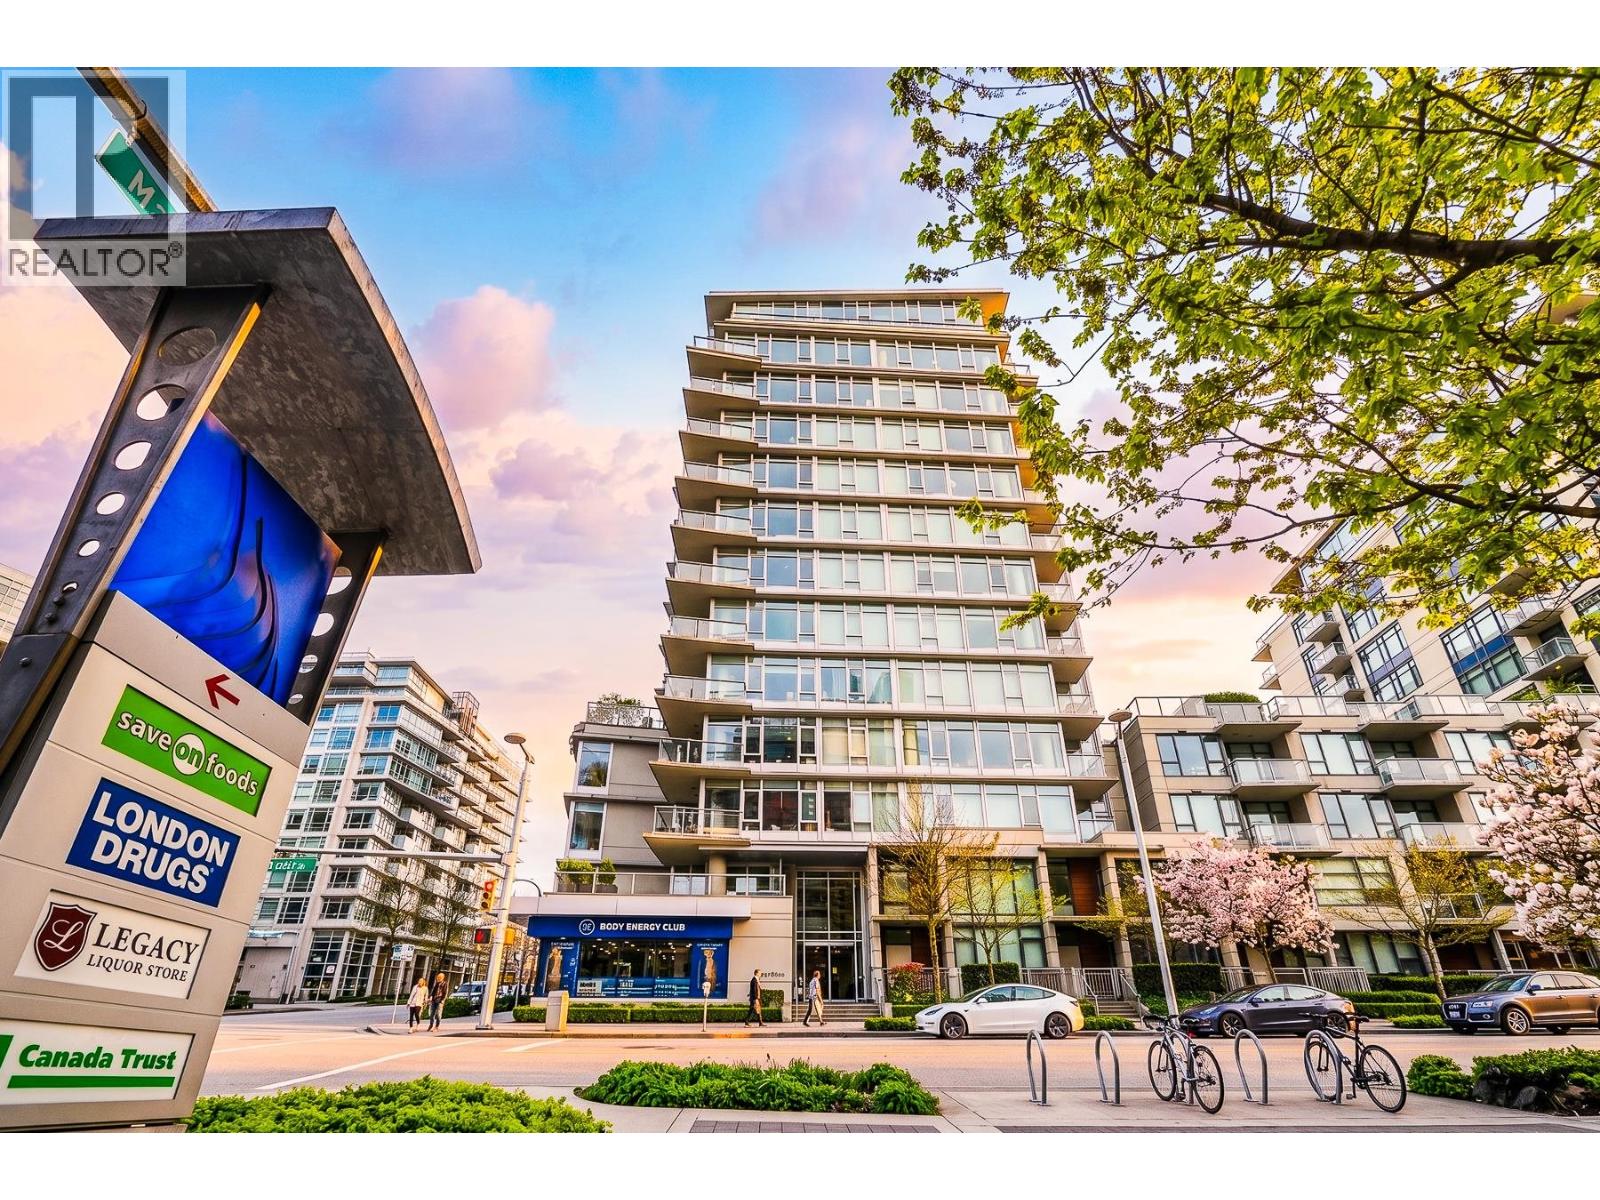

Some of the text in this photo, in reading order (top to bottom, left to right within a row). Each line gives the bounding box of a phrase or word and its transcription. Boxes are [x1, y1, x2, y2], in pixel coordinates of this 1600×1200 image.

[128, 169, 166, 214] M
[117, 712, 258, 796] save on foods
[93, 792, 230, 868] LONDON
[91, 830, 210, 894] DRUGS
[93, 923, 200, 965] LEGACY
[600, 923, 686, 931] BODY ENERGY CLUB
[87, 954, 188, 982] LIQUOR STORE
[19, 1044, 177, 1070] Canada Trust
